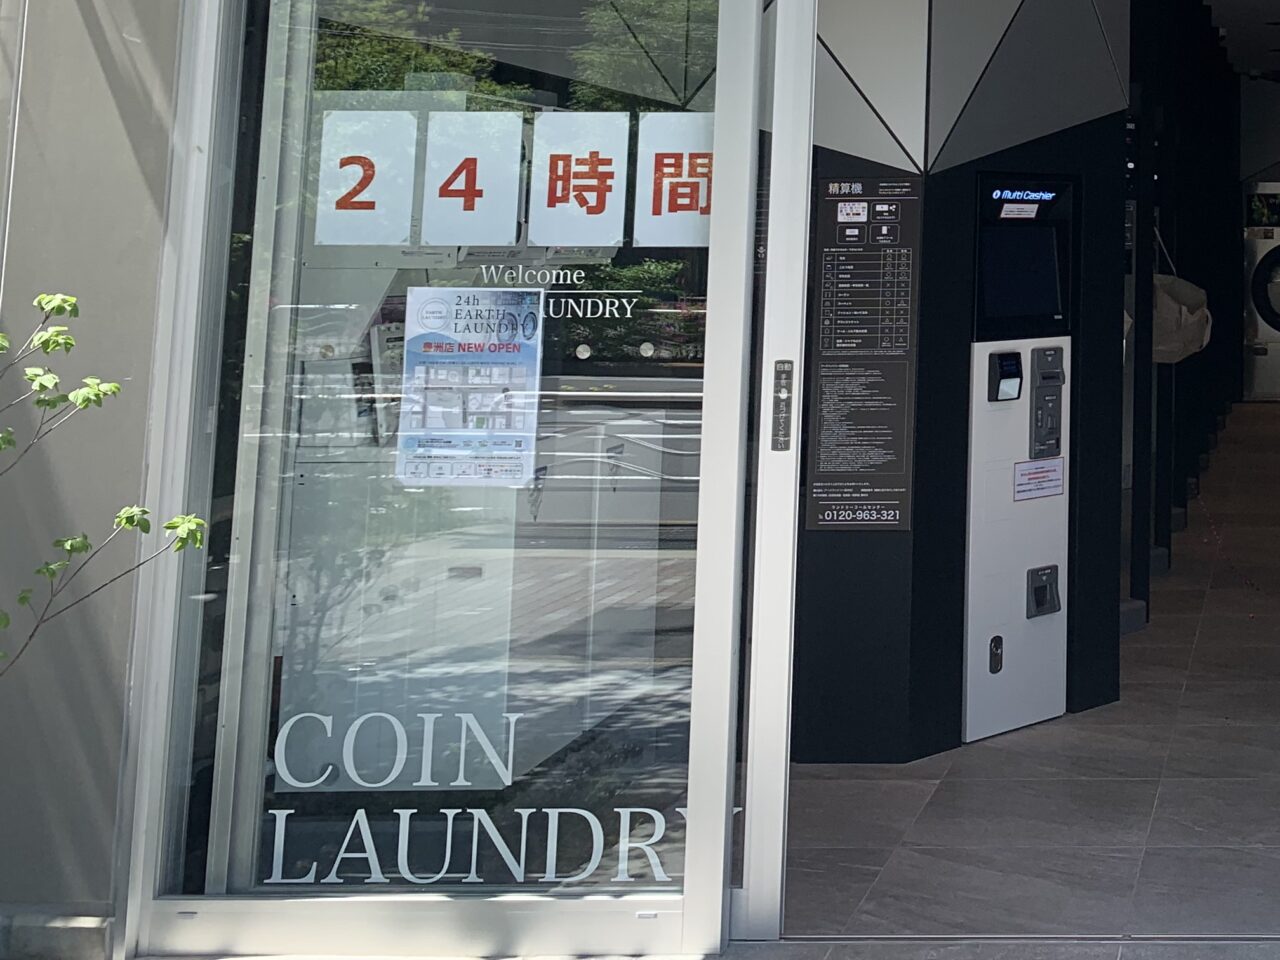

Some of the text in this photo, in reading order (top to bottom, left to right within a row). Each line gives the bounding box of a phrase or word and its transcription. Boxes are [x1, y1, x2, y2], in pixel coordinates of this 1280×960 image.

[828, 183, 863, 195] 精算機
[480, 264, 586, 285] Welcome
[455, 295, 480, 306] 24h
[454, 308, 506, 320] EARTH
[453, 322, 528, 334] LAUNDRY
[457, 342, 486, 353] NEW
[487, 342, 522, 353] OPEN
[824, 510, 900, 521] 0120-963-321
[273, 711, 525, 789] COIN
[263, 806, 742, 885] LAUNDR
